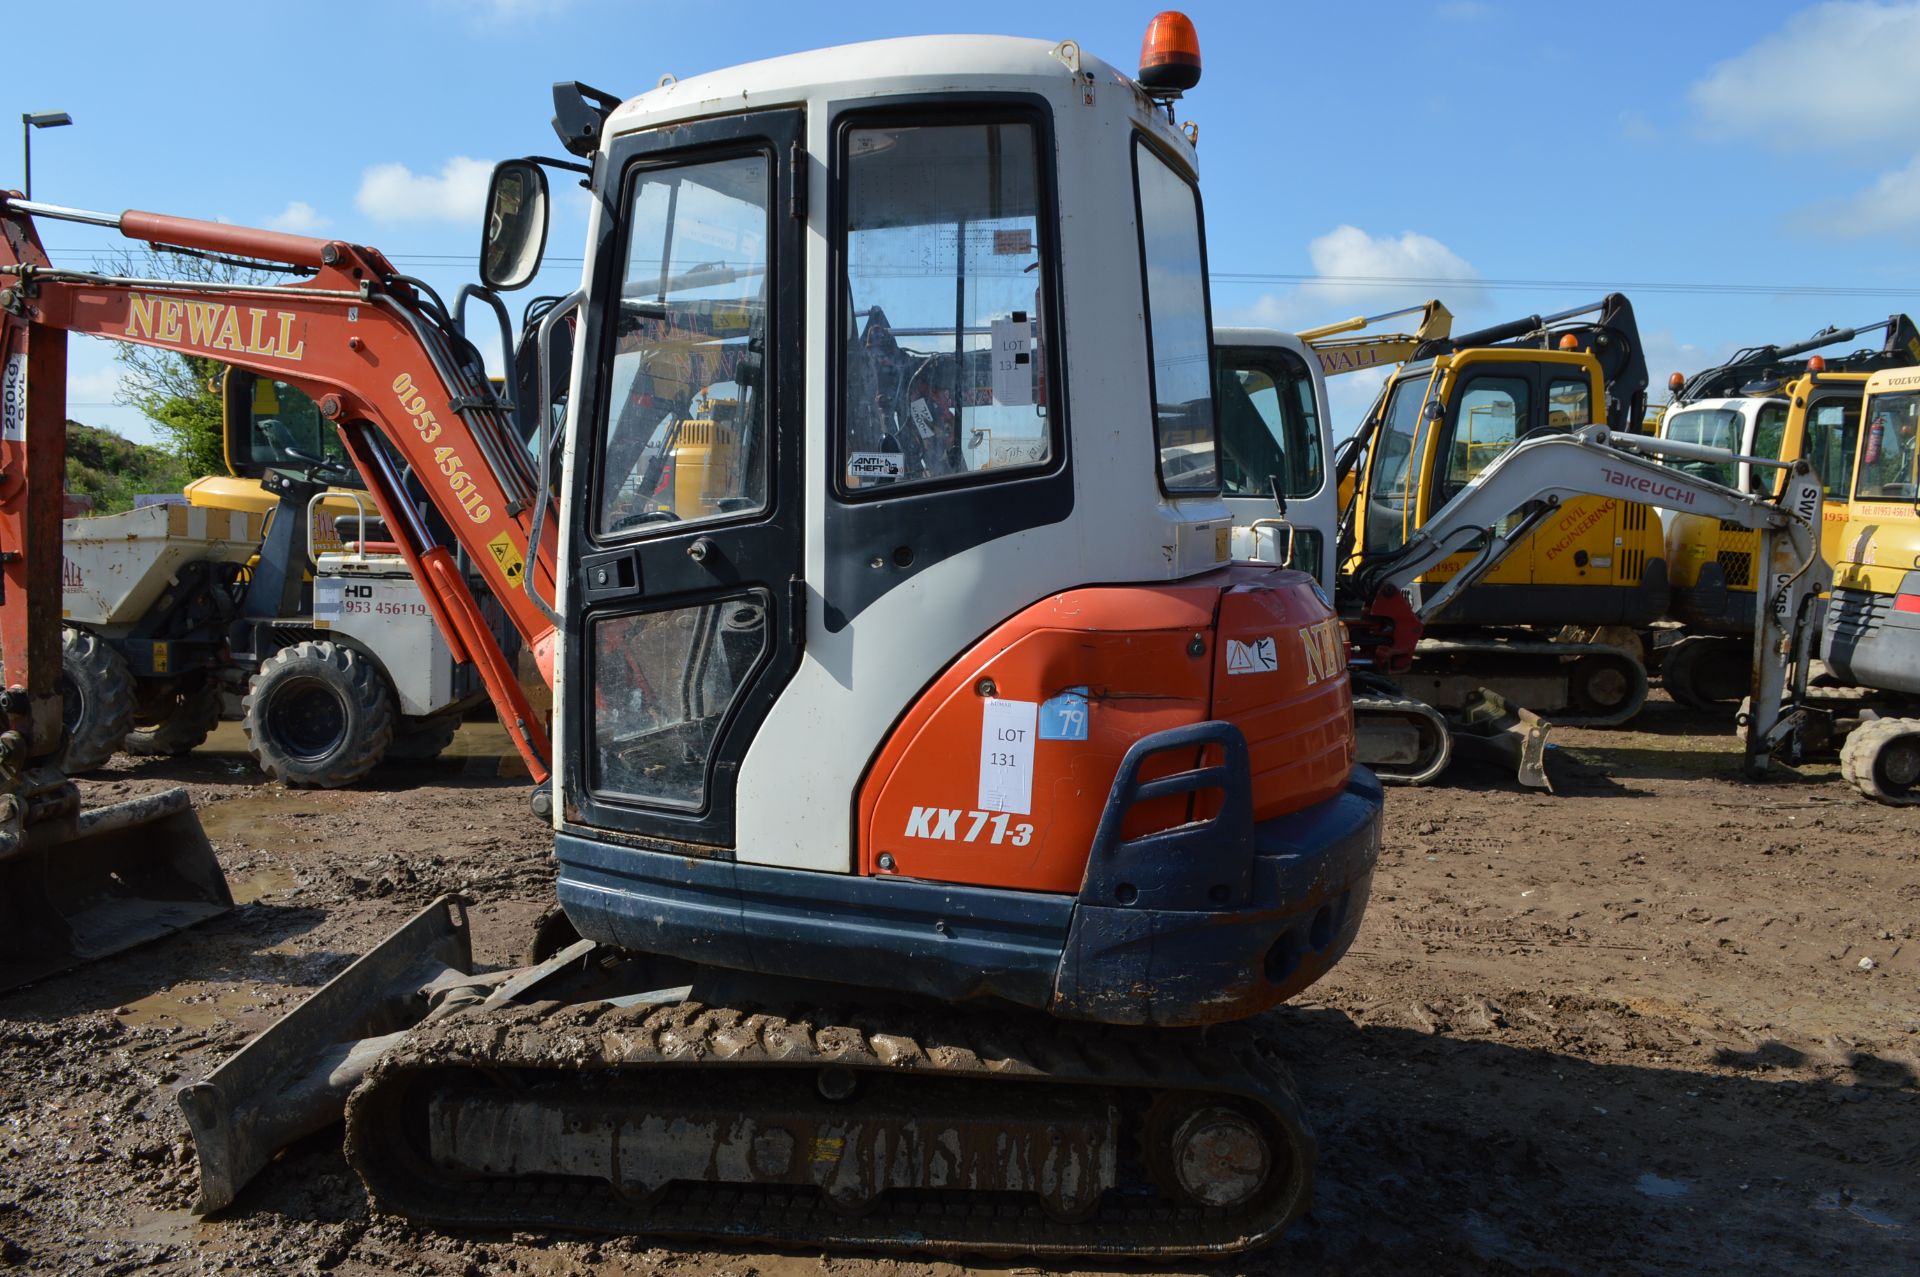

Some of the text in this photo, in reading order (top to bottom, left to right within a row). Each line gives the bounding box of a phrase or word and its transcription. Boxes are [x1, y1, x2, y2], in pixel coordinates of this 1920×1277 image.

[125, 292, 303, 360] NEWALL
[1003, 340, 1024, 351] LOT
[999, 361, 1019, 371] 131
[1888, 376, 1920, 386] VOLVO
[392, 373, 491, 524] 01953 456119
[853, 457, 880, 465] ANTI
[853, 464, 884, 472] THEFT
[1560, 506, 1587, 532] CIVIL
[1546, 498, 1616, 561] ENGINEERING
[62, 557, 84, 587] ALL
[345, 585, 372, 598] HD
[376, 602, 426, 615] 456119
[1059, 710, 1085, 736] 79
[998, 727, 1027, 743] LOT
[990, 752, 1016, 768] 131
[904, 806, 1034, 847] KX 71-3
